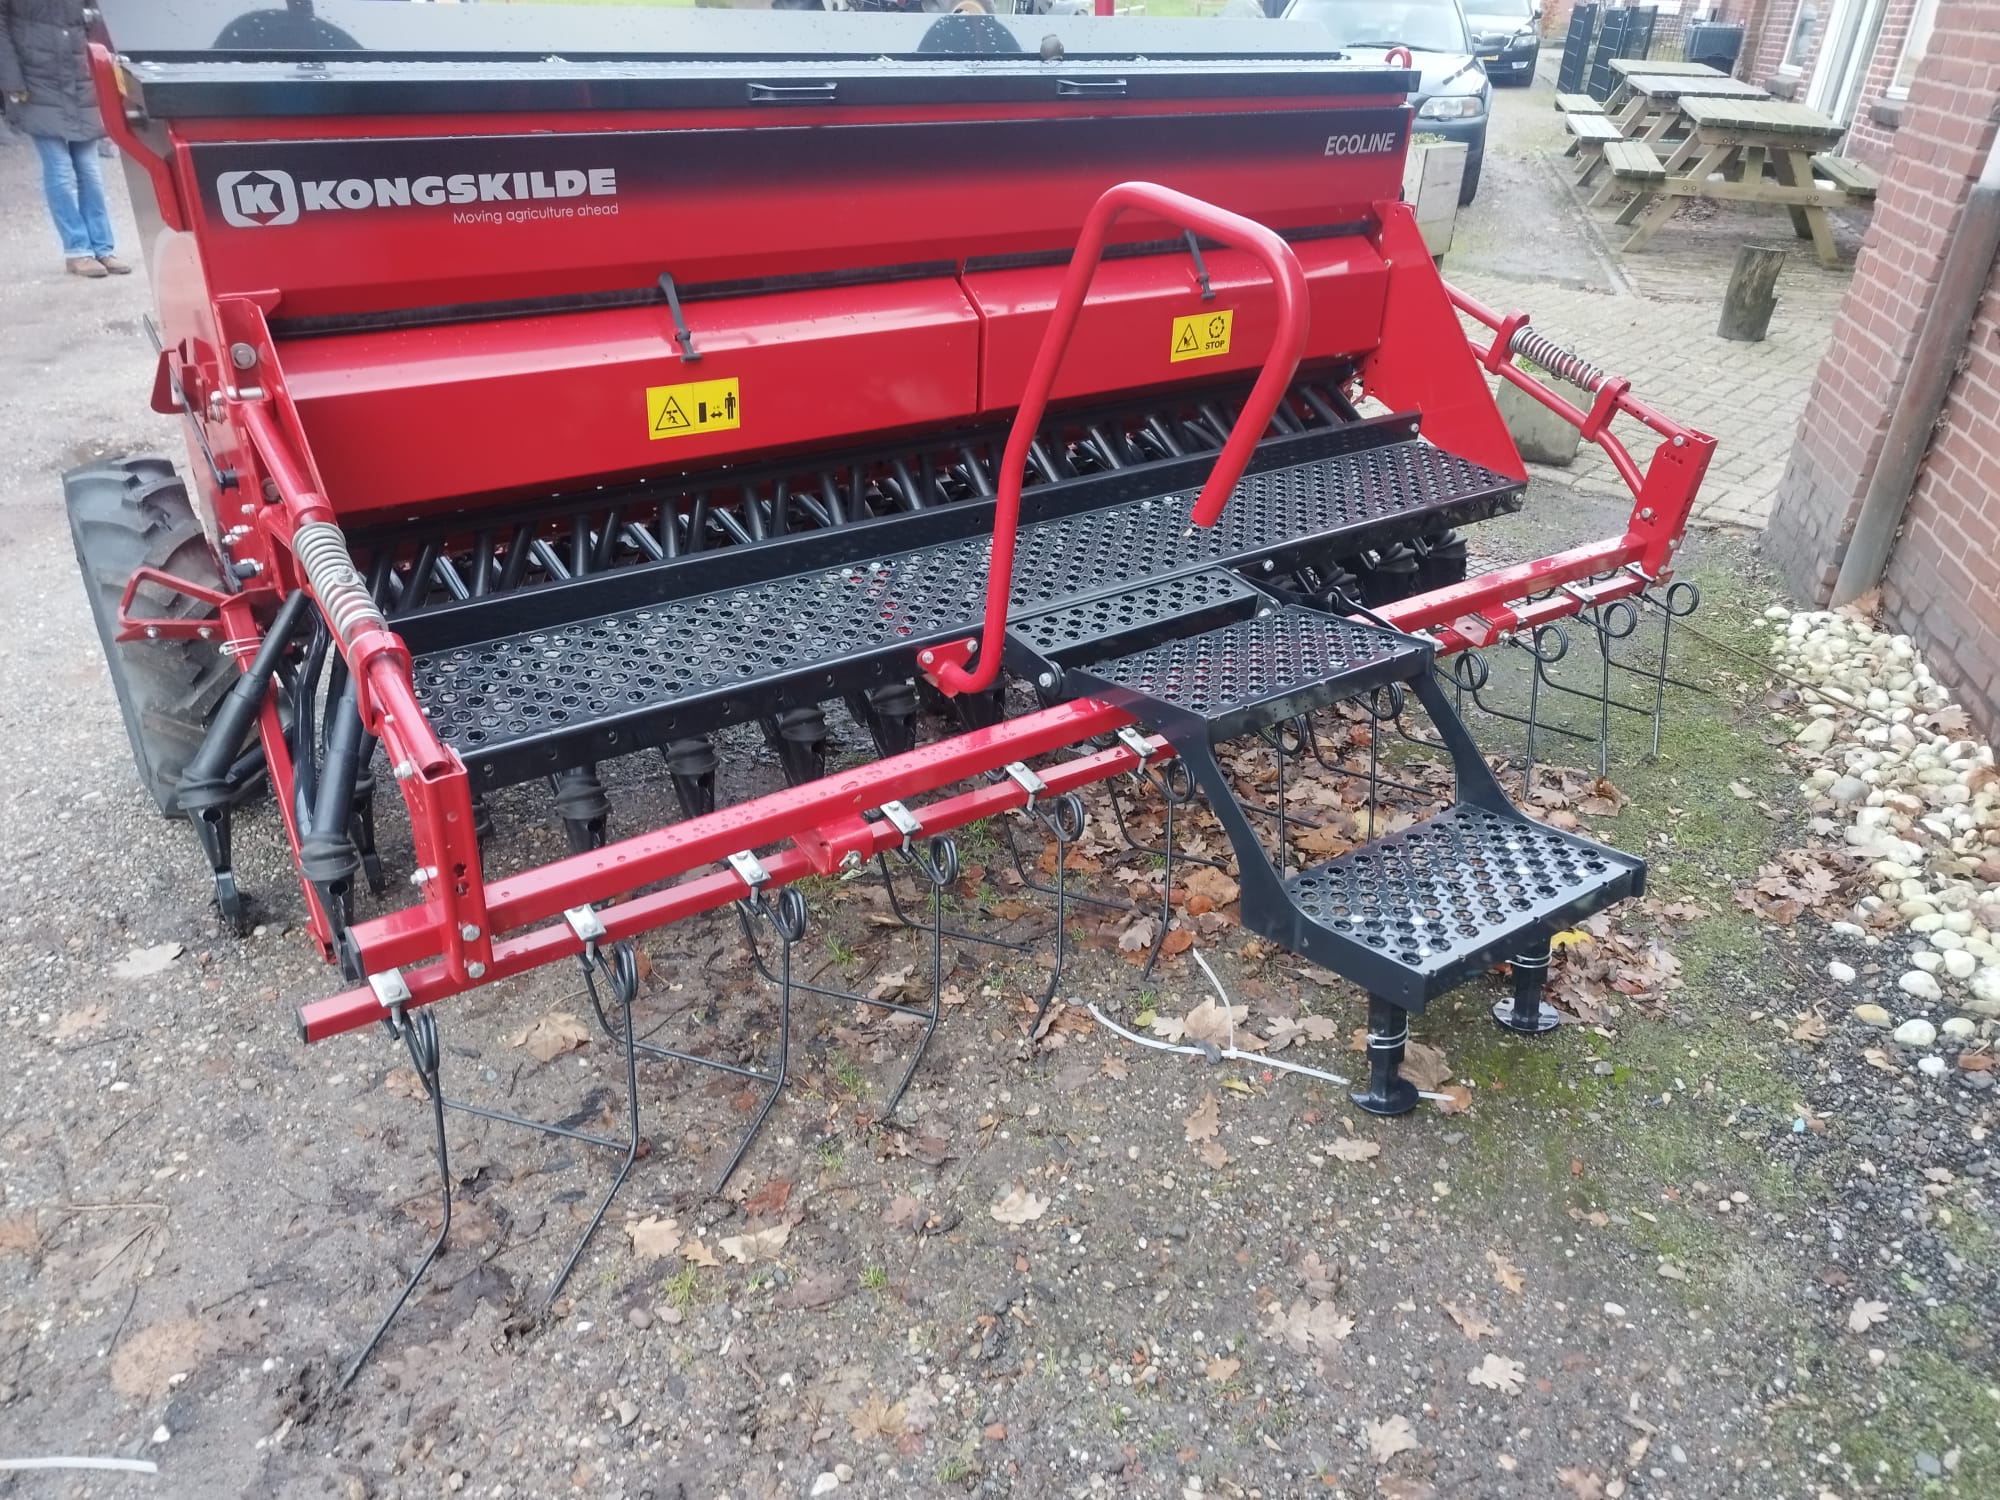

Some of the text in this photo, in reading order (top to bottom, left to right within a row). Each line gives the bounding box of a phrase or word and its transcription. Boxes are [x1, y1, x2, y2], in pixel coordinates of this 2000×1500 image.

[1324, 132, 1396, 156] ECOLINE
[236, 168, 617, 215] K KONGSKILDE
[453, 203, 619, 224] Moving agriculture ahead
[1205, 340, 1225, 350] STOP
